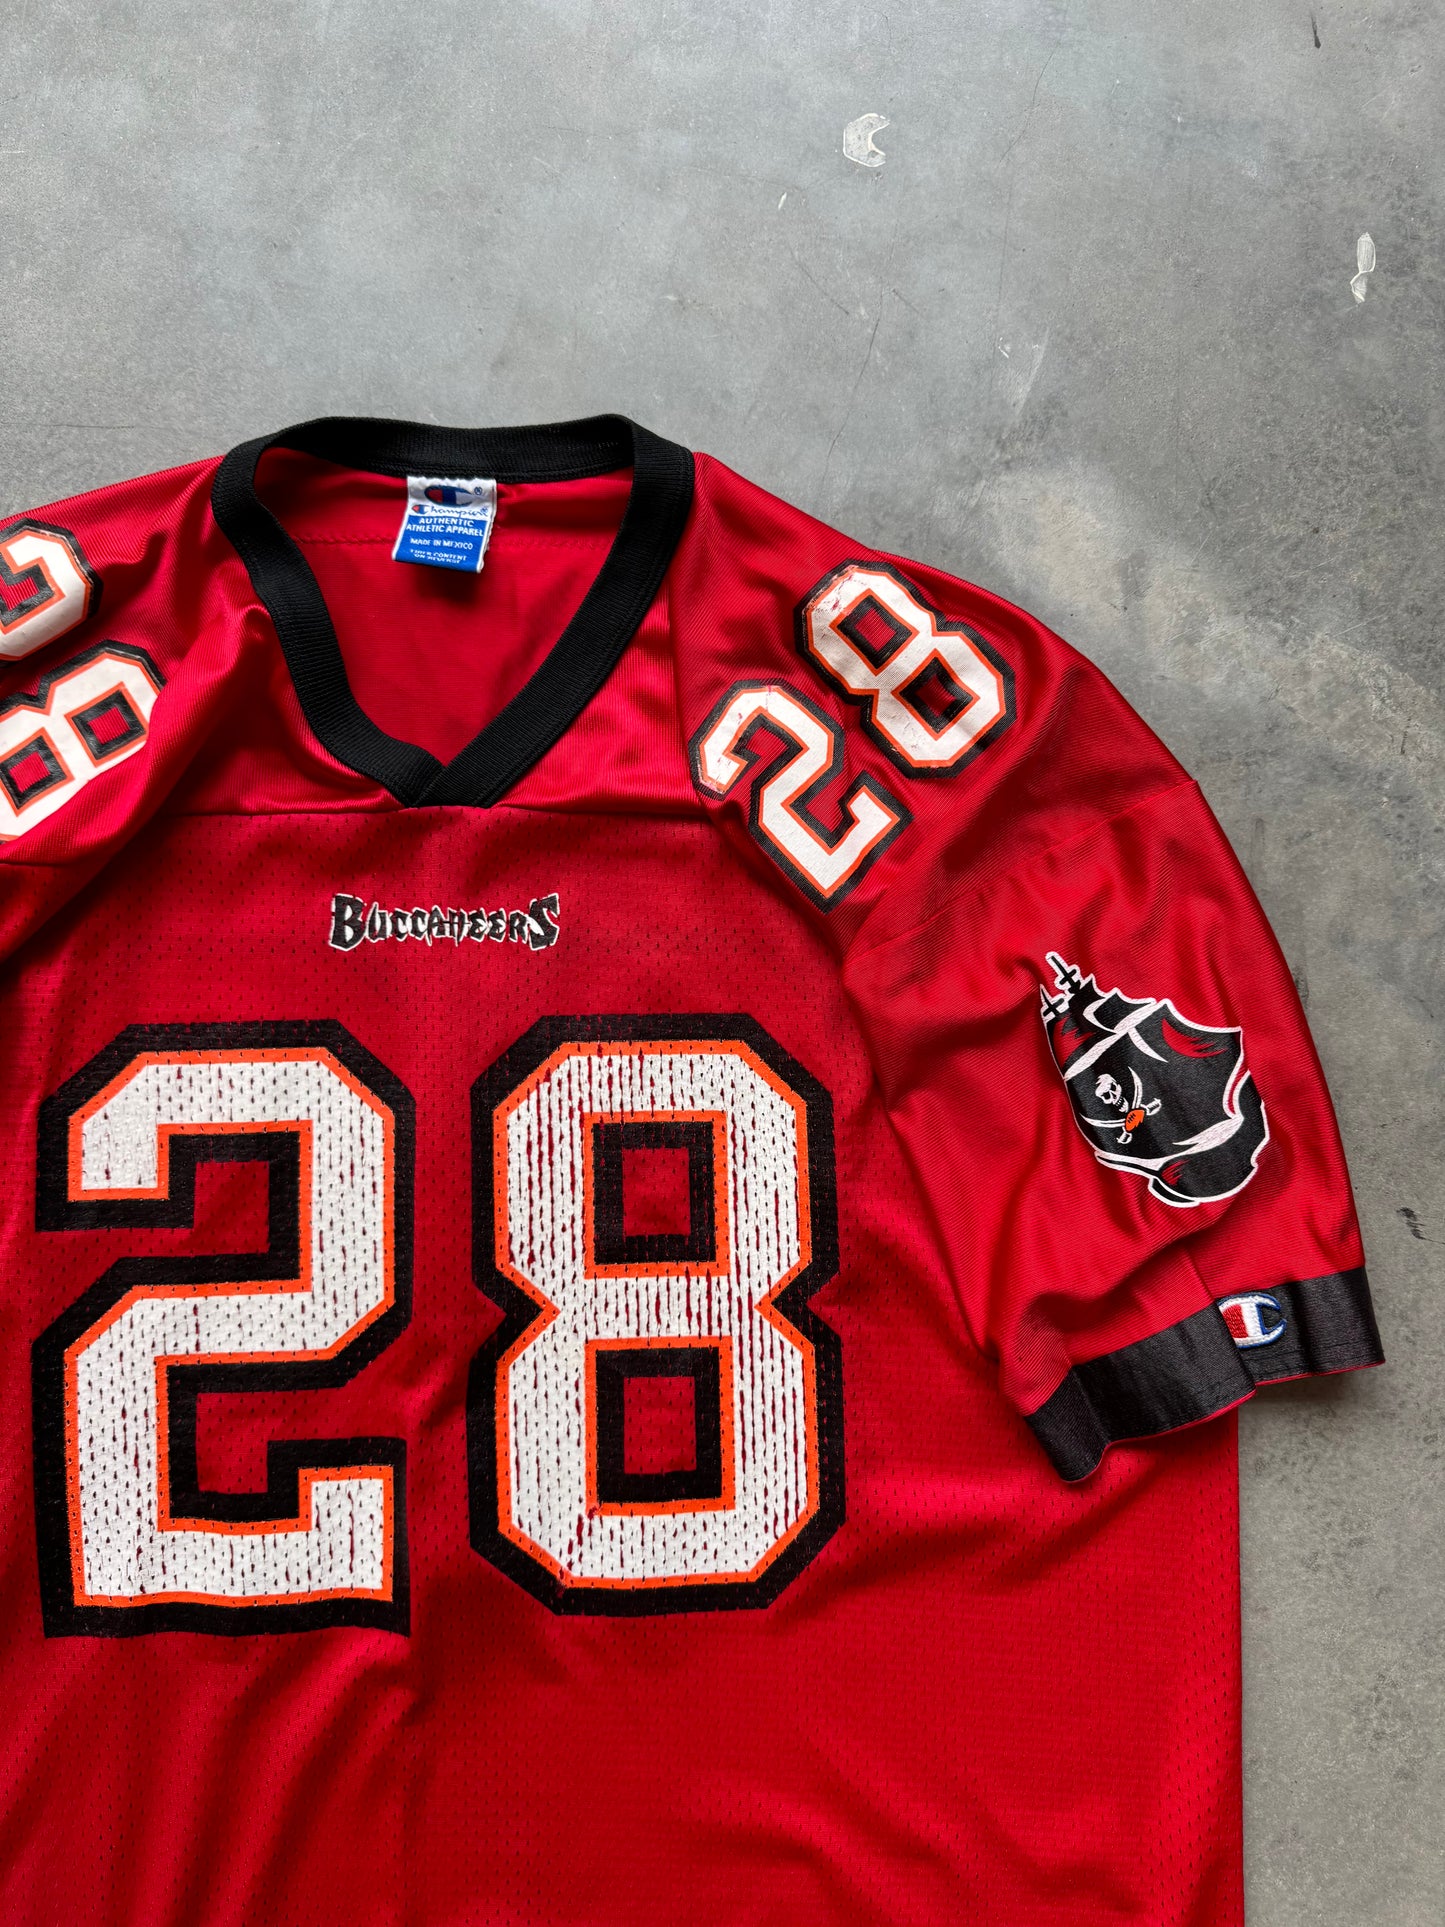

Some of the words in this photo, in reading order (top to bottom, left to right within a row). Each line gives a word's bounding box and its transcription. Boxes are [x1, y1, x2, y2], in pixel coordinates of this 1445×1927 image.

[419, 517, 475, 527] AUTHENTIC
[406, 524, 445, 533] ATHLETIC
[445, 525, 484, 537] APPAREL
[410, 537, 431, 546] MADE
[433, 539, 442, 547] IN
[442, 540, 474, 550] MEXICO
[688, 559, 1017, 915] 28
[32, 1013, 846, 1638] 28
